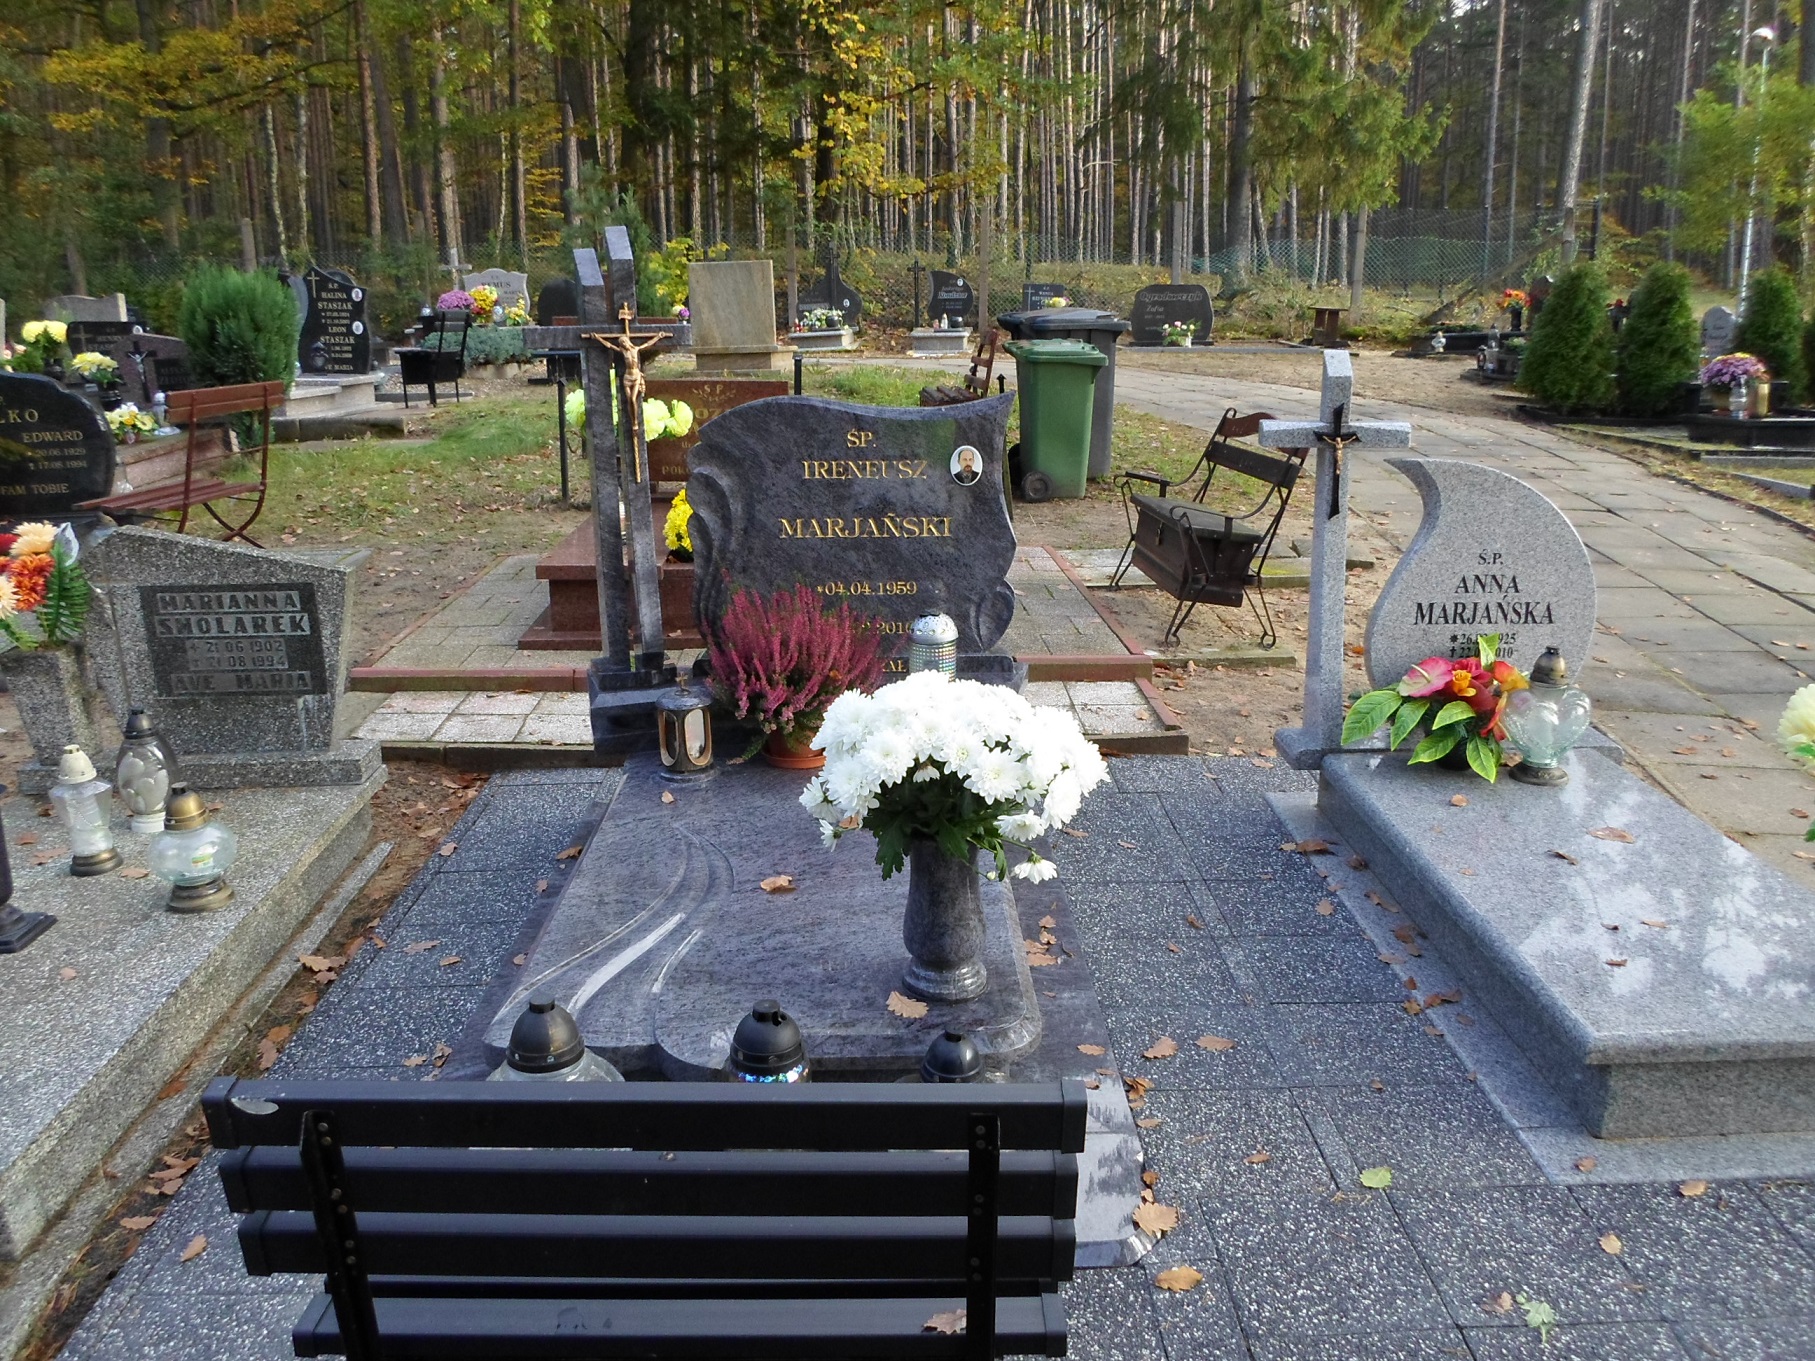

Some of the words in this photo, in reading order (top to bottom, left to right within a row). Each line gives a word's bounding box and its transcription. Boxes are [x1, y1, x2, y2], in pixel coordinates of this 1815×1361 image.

[22, 430, 84, 442] EDWARD
[802, 460, 928, 480] IRENEUSZ
[31, 483, 70, 494] TOBIE
[1454, 574, 1520, 593] ANNA
[158, 592, 298, 610] MARIANNA
[1413, 594, 1554, 625] MARJAŃSKA
[157, 615, 308, 636] SMOLAREK
[225, 641, 244, 652] 06
[251, 640, 284, 652] 1902
[228, 656, 247, 668] 08
[253, 656, 286, 667] 1994
[174, 675, 216, 692] AVE
[235, 673, 311, 690] MARIA
